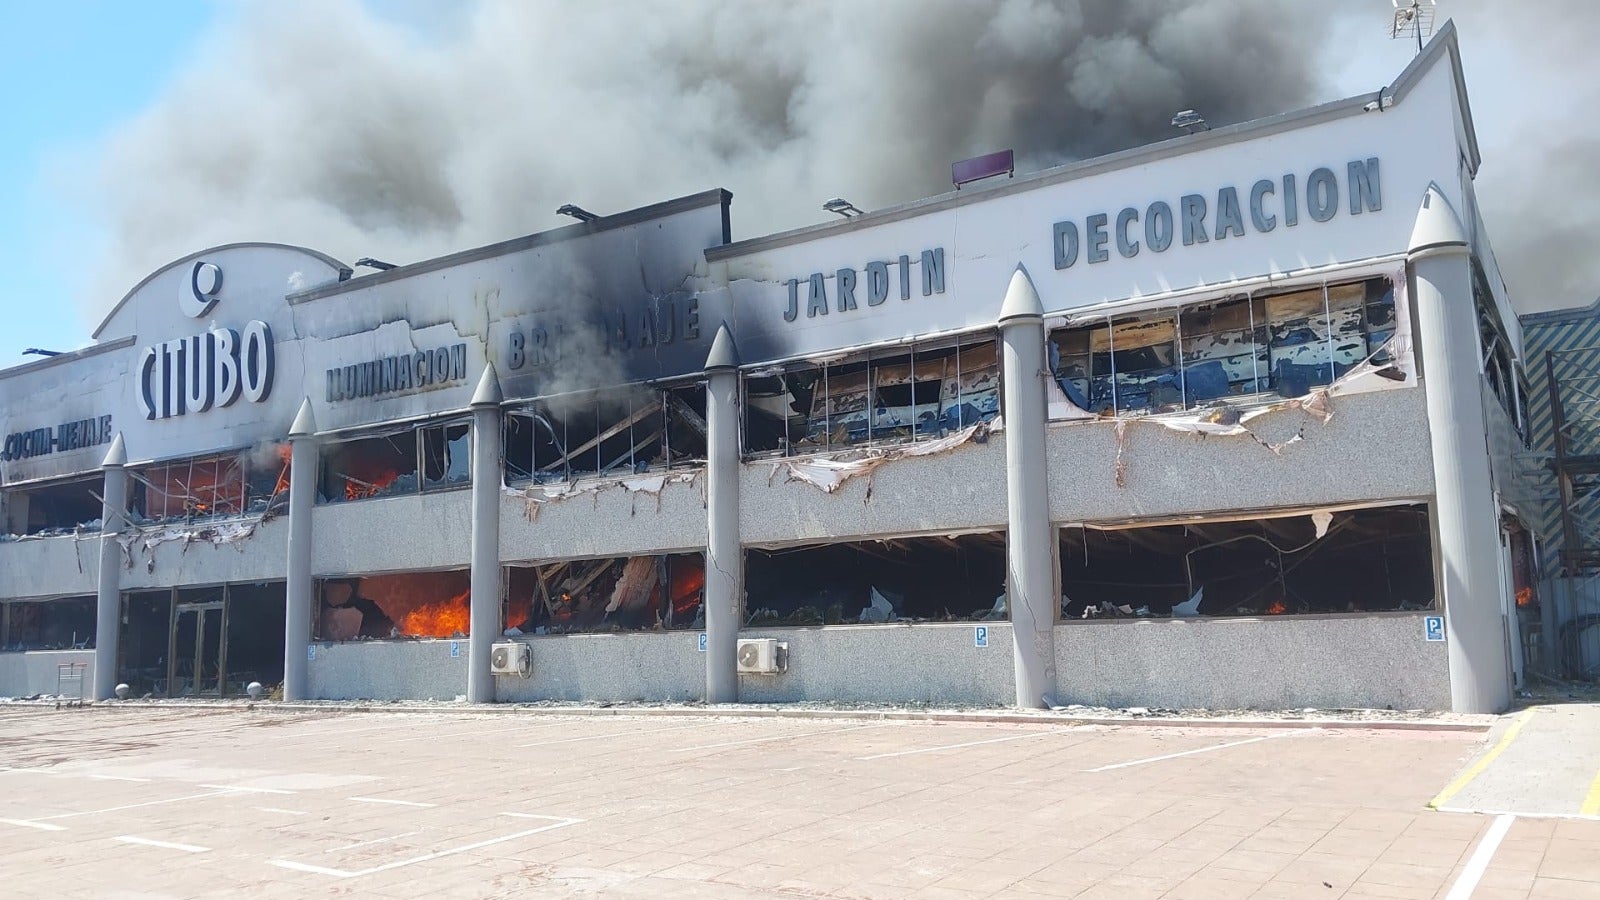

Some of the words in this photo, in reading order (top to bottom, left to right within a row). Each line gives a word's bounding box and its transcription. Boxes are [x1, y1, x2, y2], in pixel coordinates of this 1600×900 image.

[1053, 157, 1382, 271] DECORACION
[784, 247, 945, 322] JARDIN
[135, 320, 275, 420] CITUBO
[326, 343, 466, 402] ILUMINACION
[978, 628, 985, 640] P
[1429, 619, 1438, 632] P
